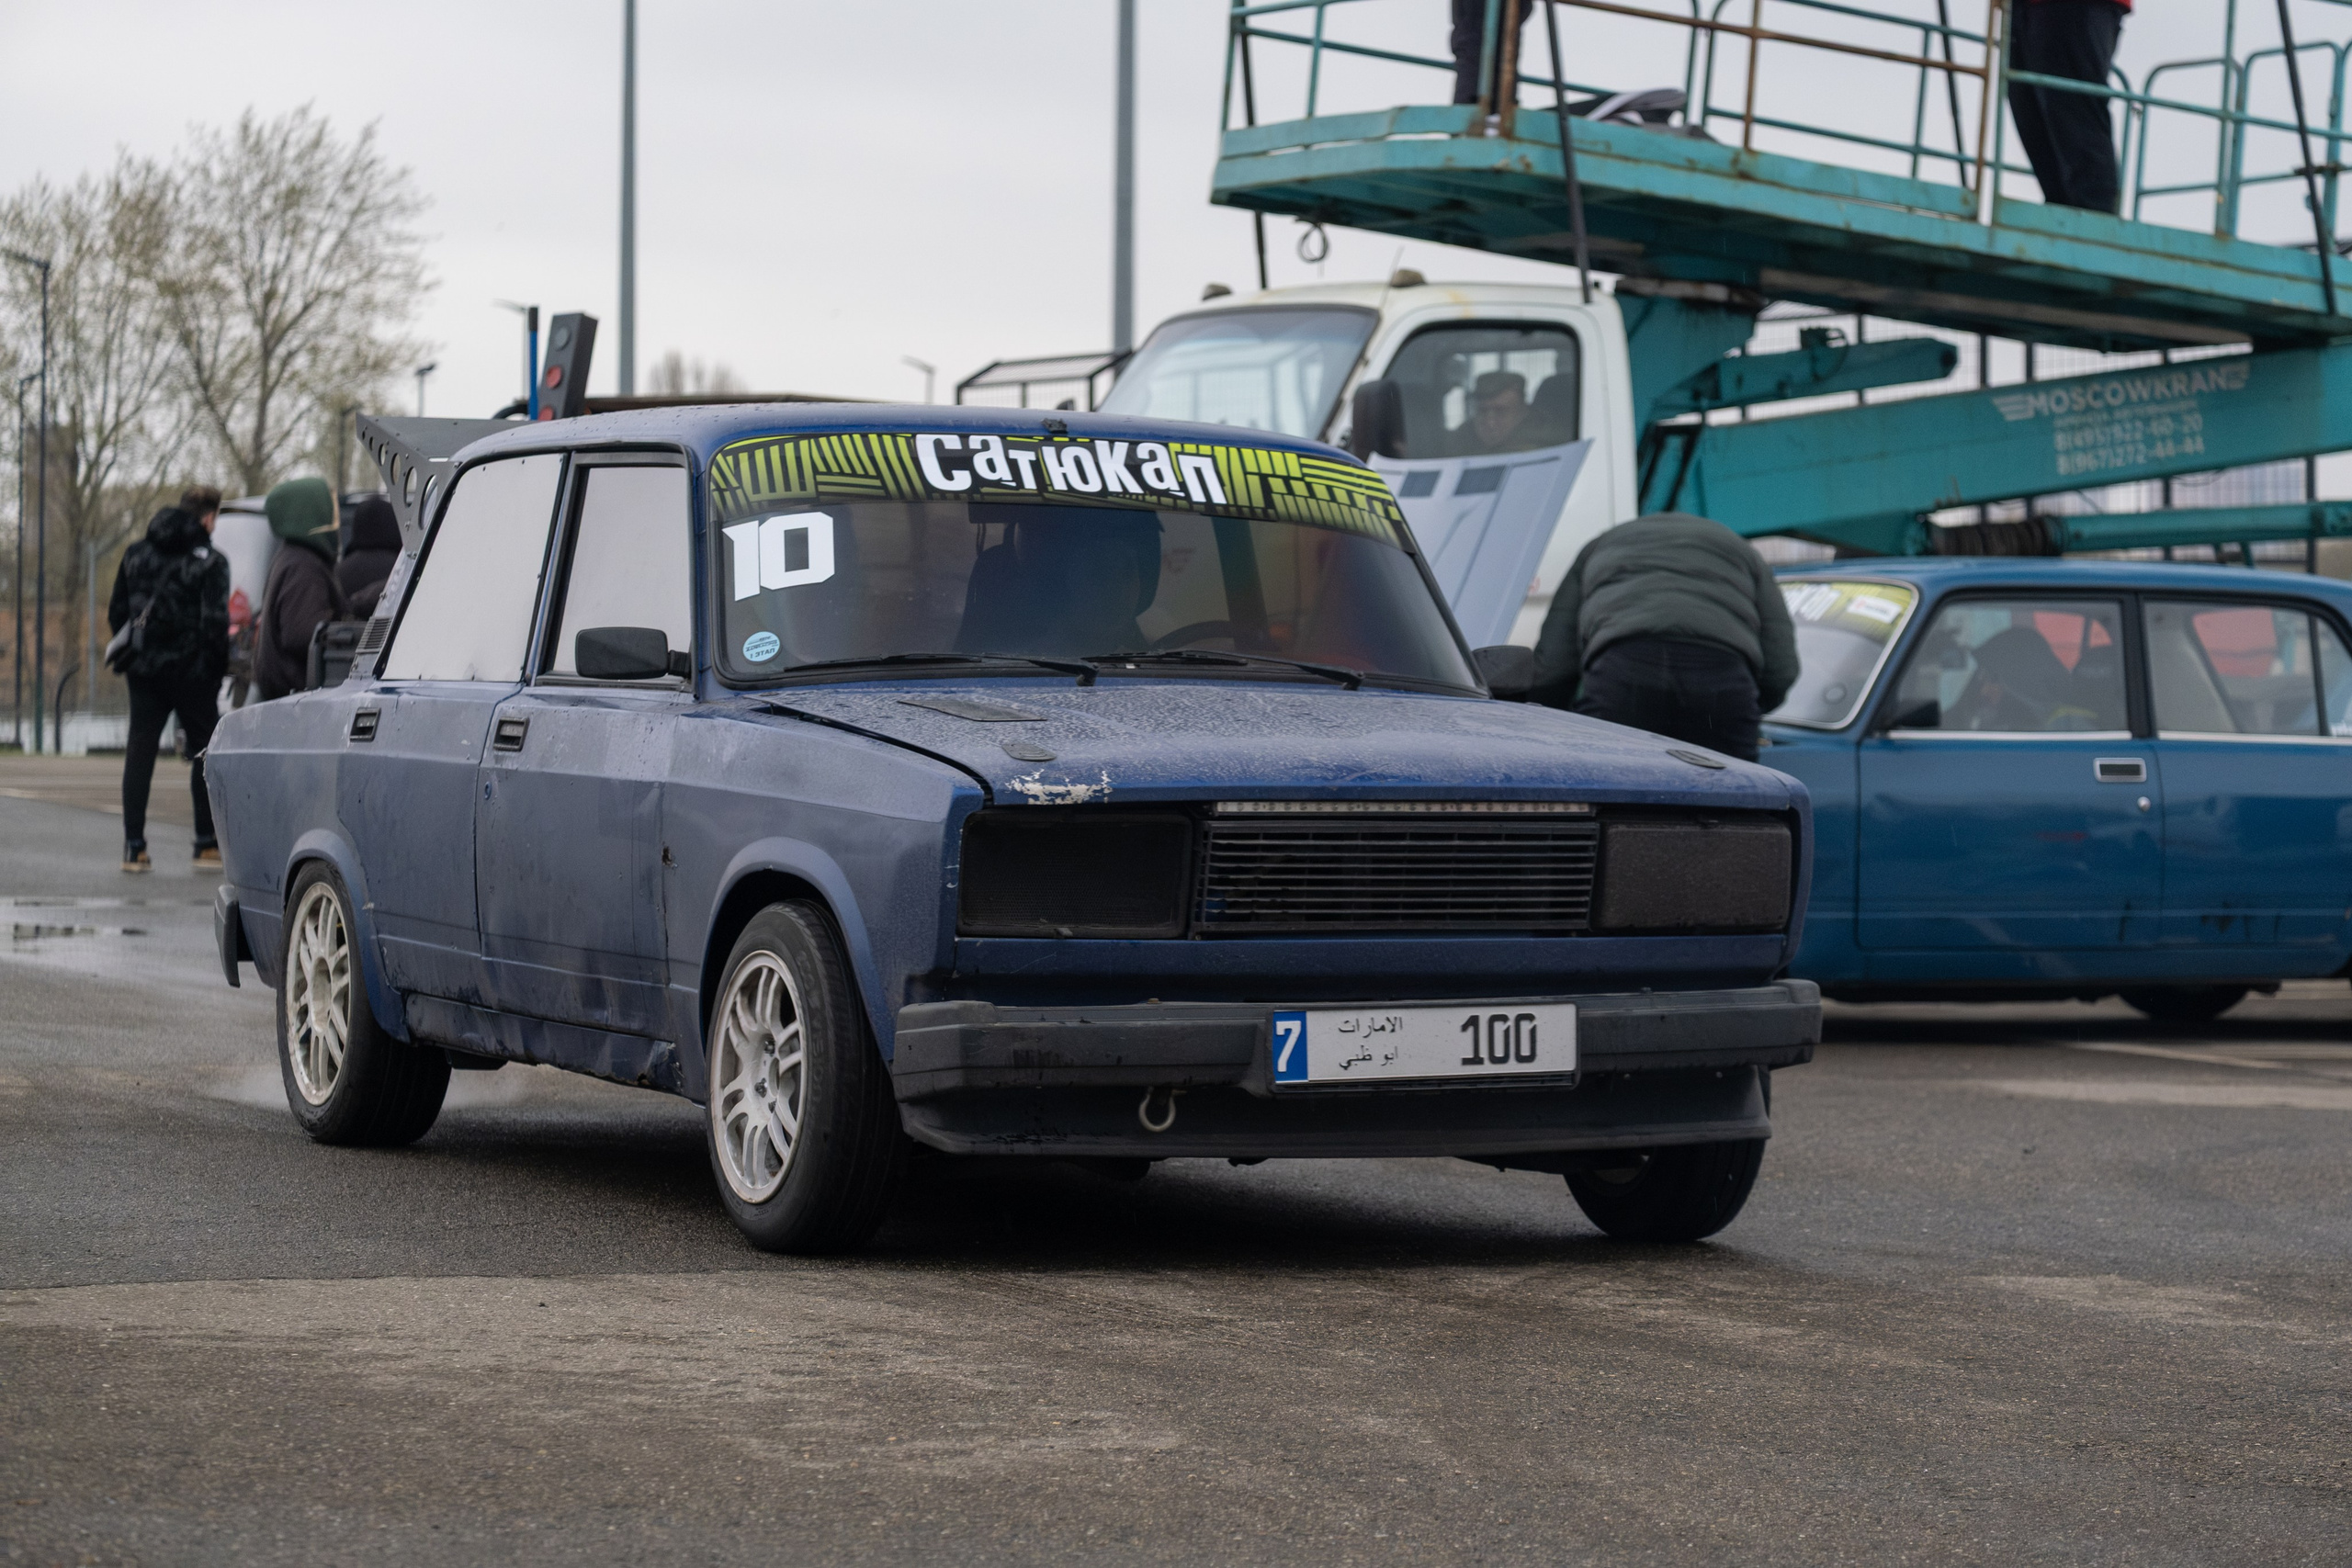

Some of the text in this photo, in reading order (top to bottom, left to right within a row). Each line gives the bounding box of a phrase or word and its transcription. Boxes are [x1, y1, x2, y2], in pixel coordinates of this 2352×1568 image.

[2029, 368, 2226, 416] MOSCOWKRAN
[721, 512, 835, 602] 10
[754, 648, 775, 658] ЭТАП
[1275, 1021, 1302, 1073] 7
[1461, 1012, 1538, 1066] 100
